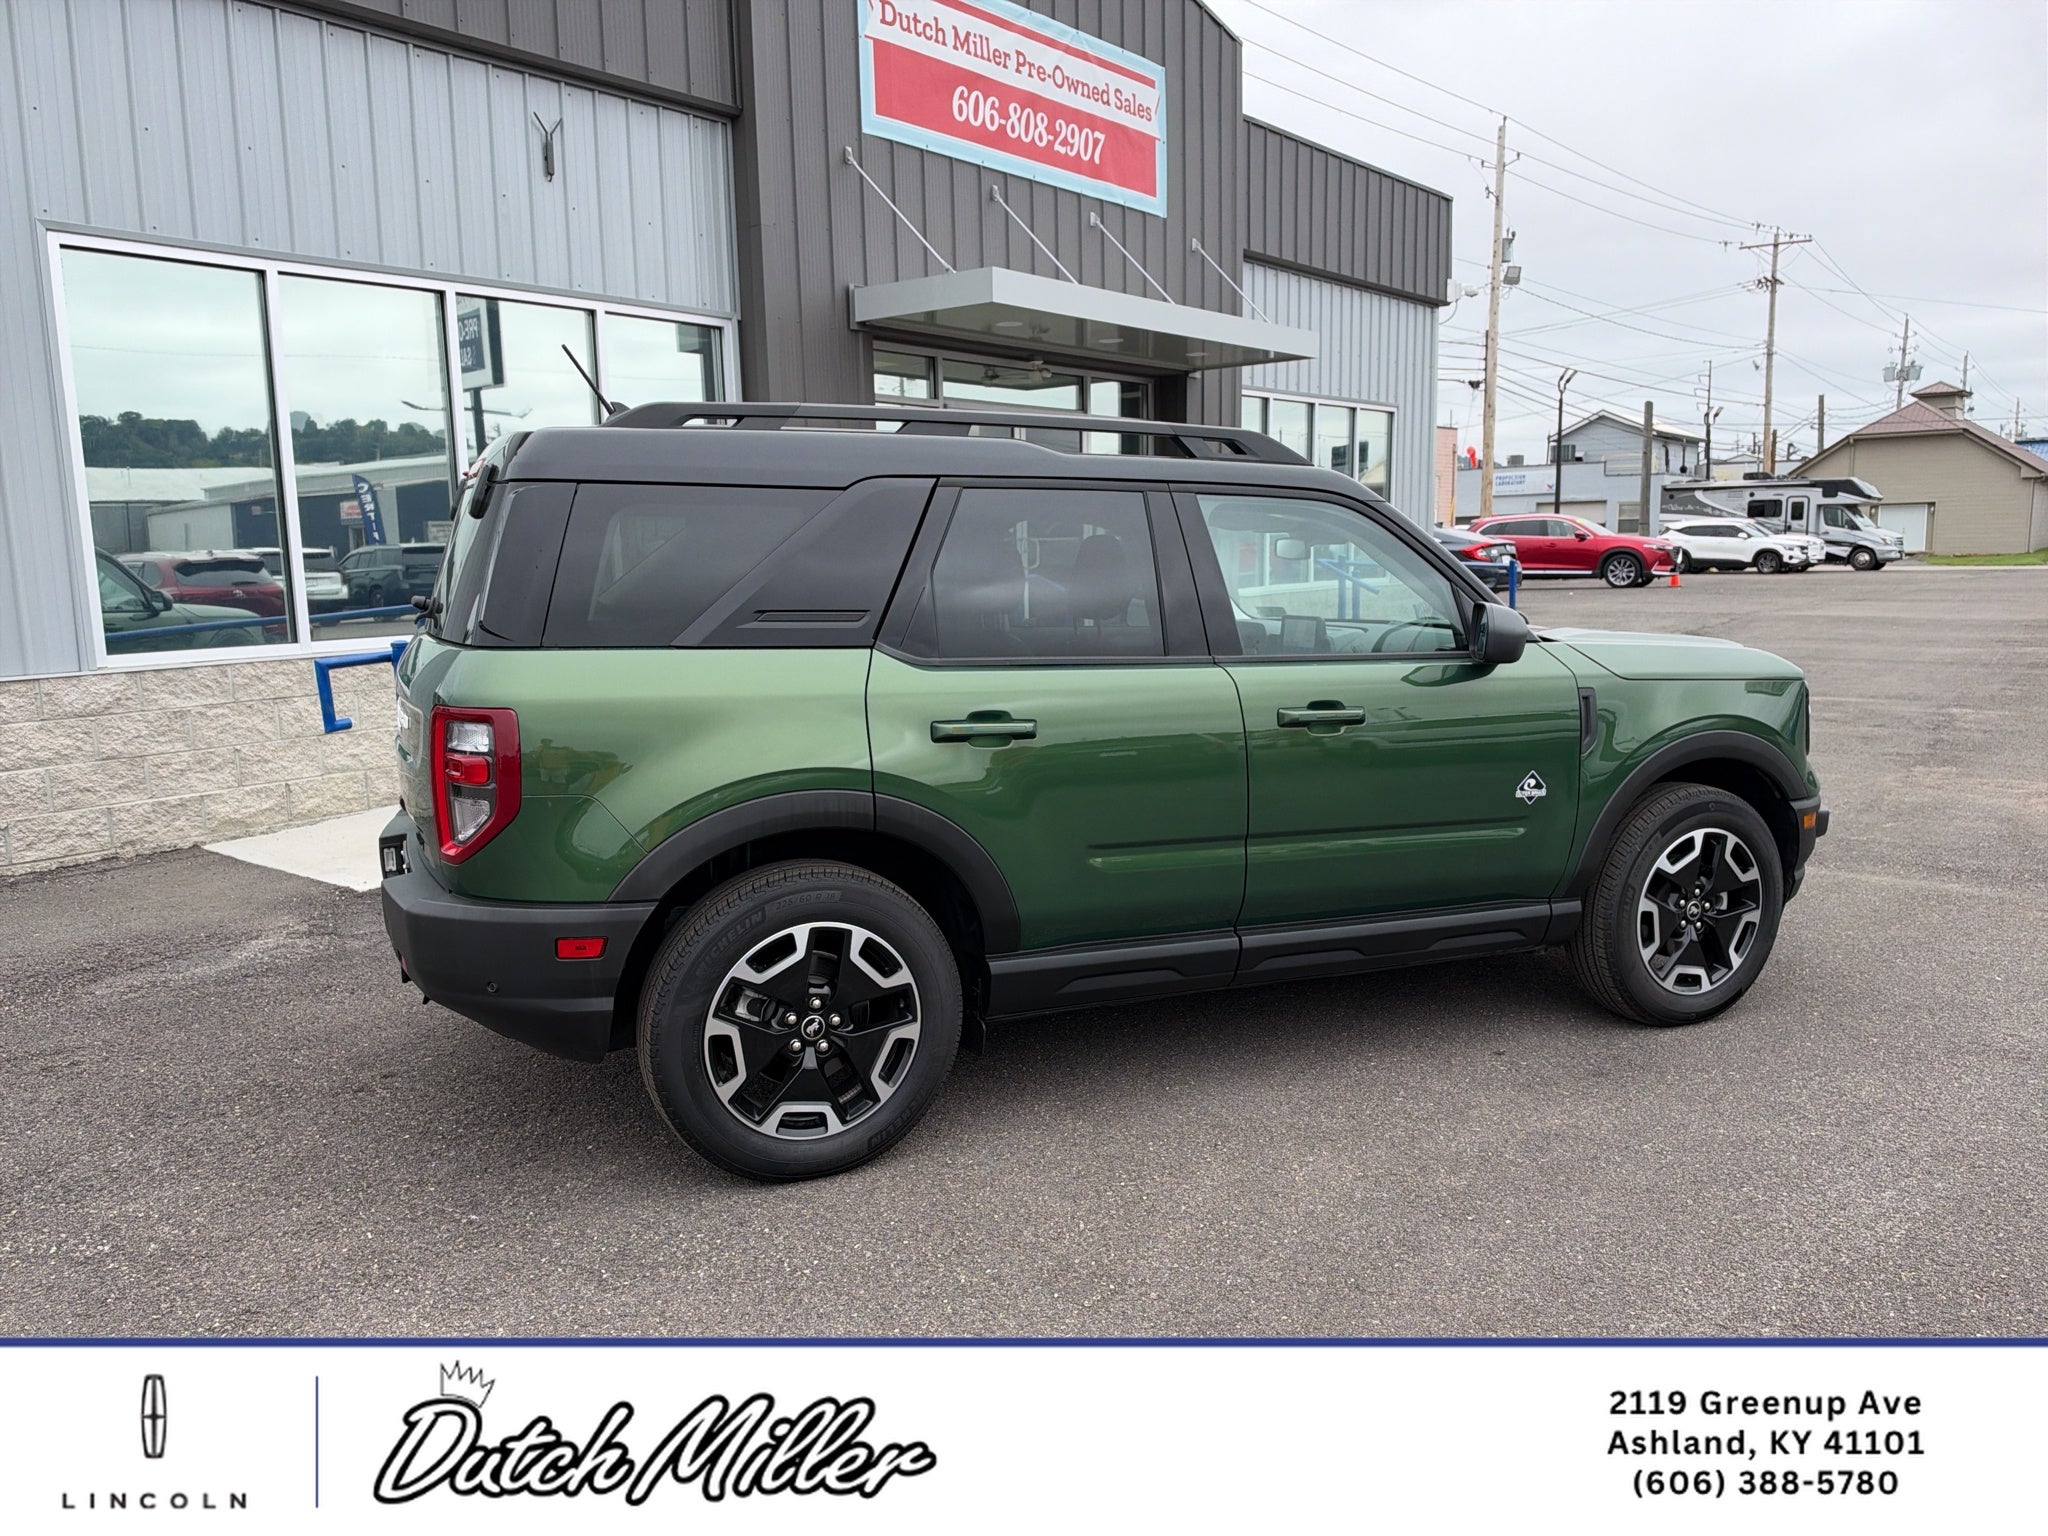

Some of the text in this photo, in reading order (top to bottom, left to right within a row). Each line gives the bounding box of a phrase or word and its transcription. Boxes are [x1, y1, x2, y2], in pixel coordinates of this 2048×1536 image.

[879, 0, 1152, 122] Dutch Miller Pre-Owned Sales
[952, 85, 1106, 164] 606-808-2907
